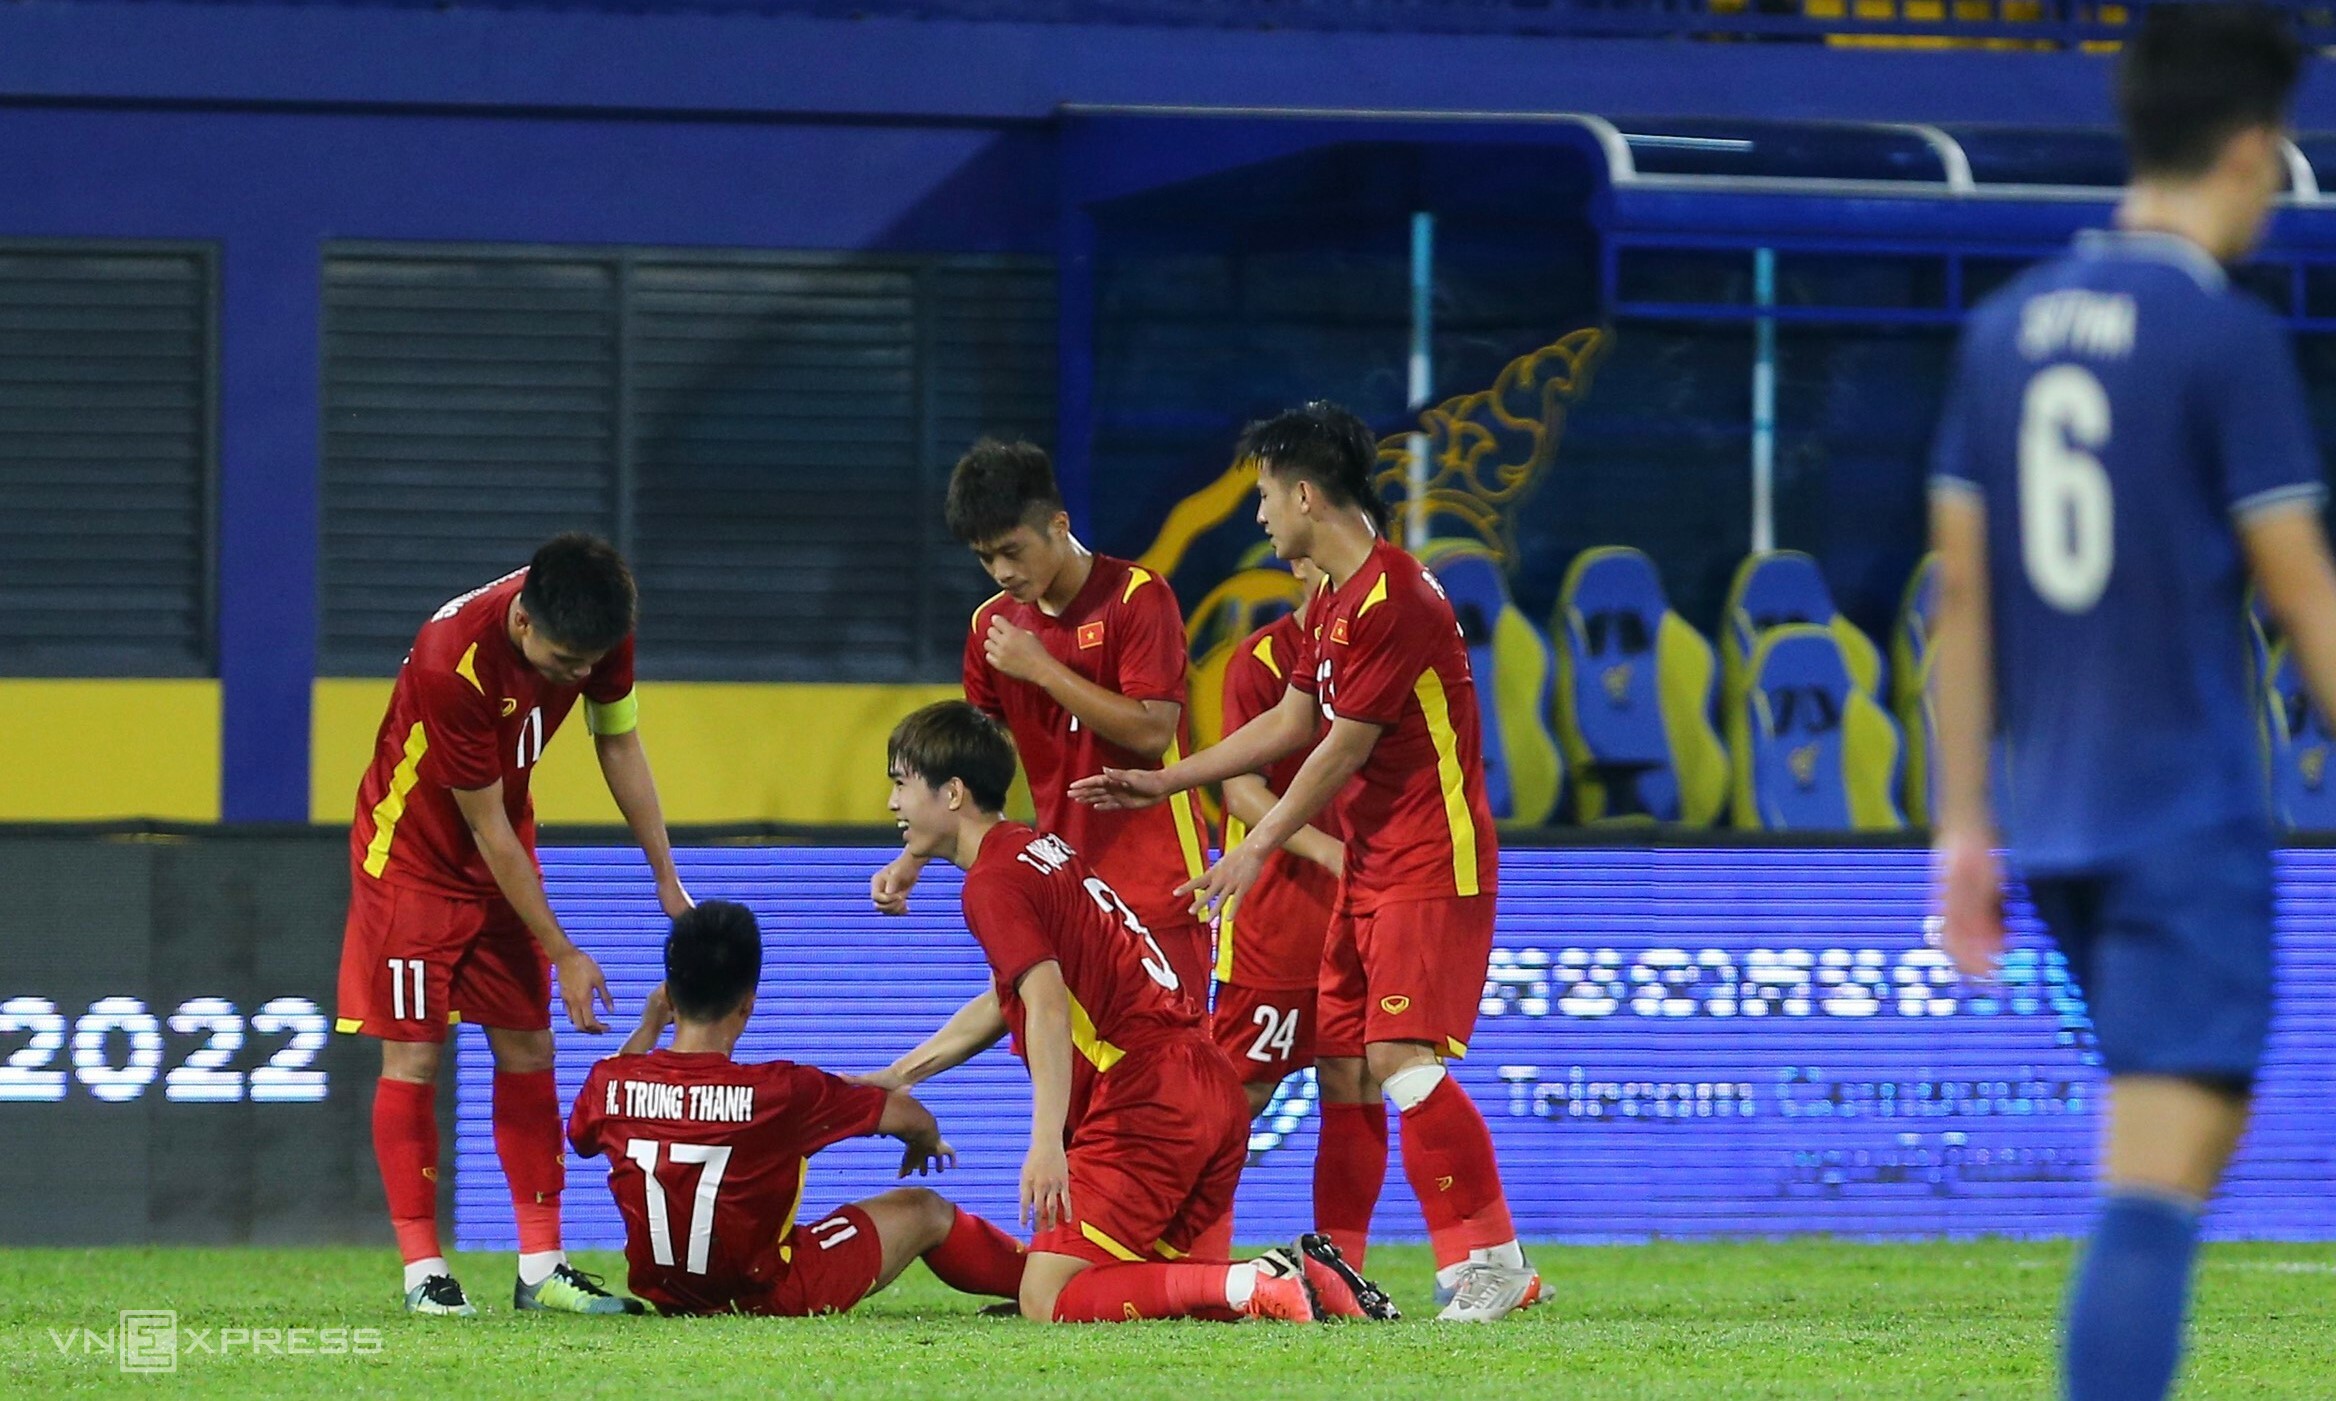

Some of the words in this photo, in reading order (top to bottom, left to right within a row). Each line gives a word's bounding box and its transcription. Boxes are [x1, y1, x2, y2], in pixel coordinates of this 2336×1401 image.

[2019, 364, 2115, 613] 6
[1082, 877, 1180, 991] 3
[388, 958, 425, 1020] 11
[1246, 1004, 1299, 1062] 24
[0, 996, 330, 1102] 2022
[624, 1080, 685, 1119] TRUNG
[688, 1085, 754, 1121] THANH
[626, 1138, 732, 1275] 17
